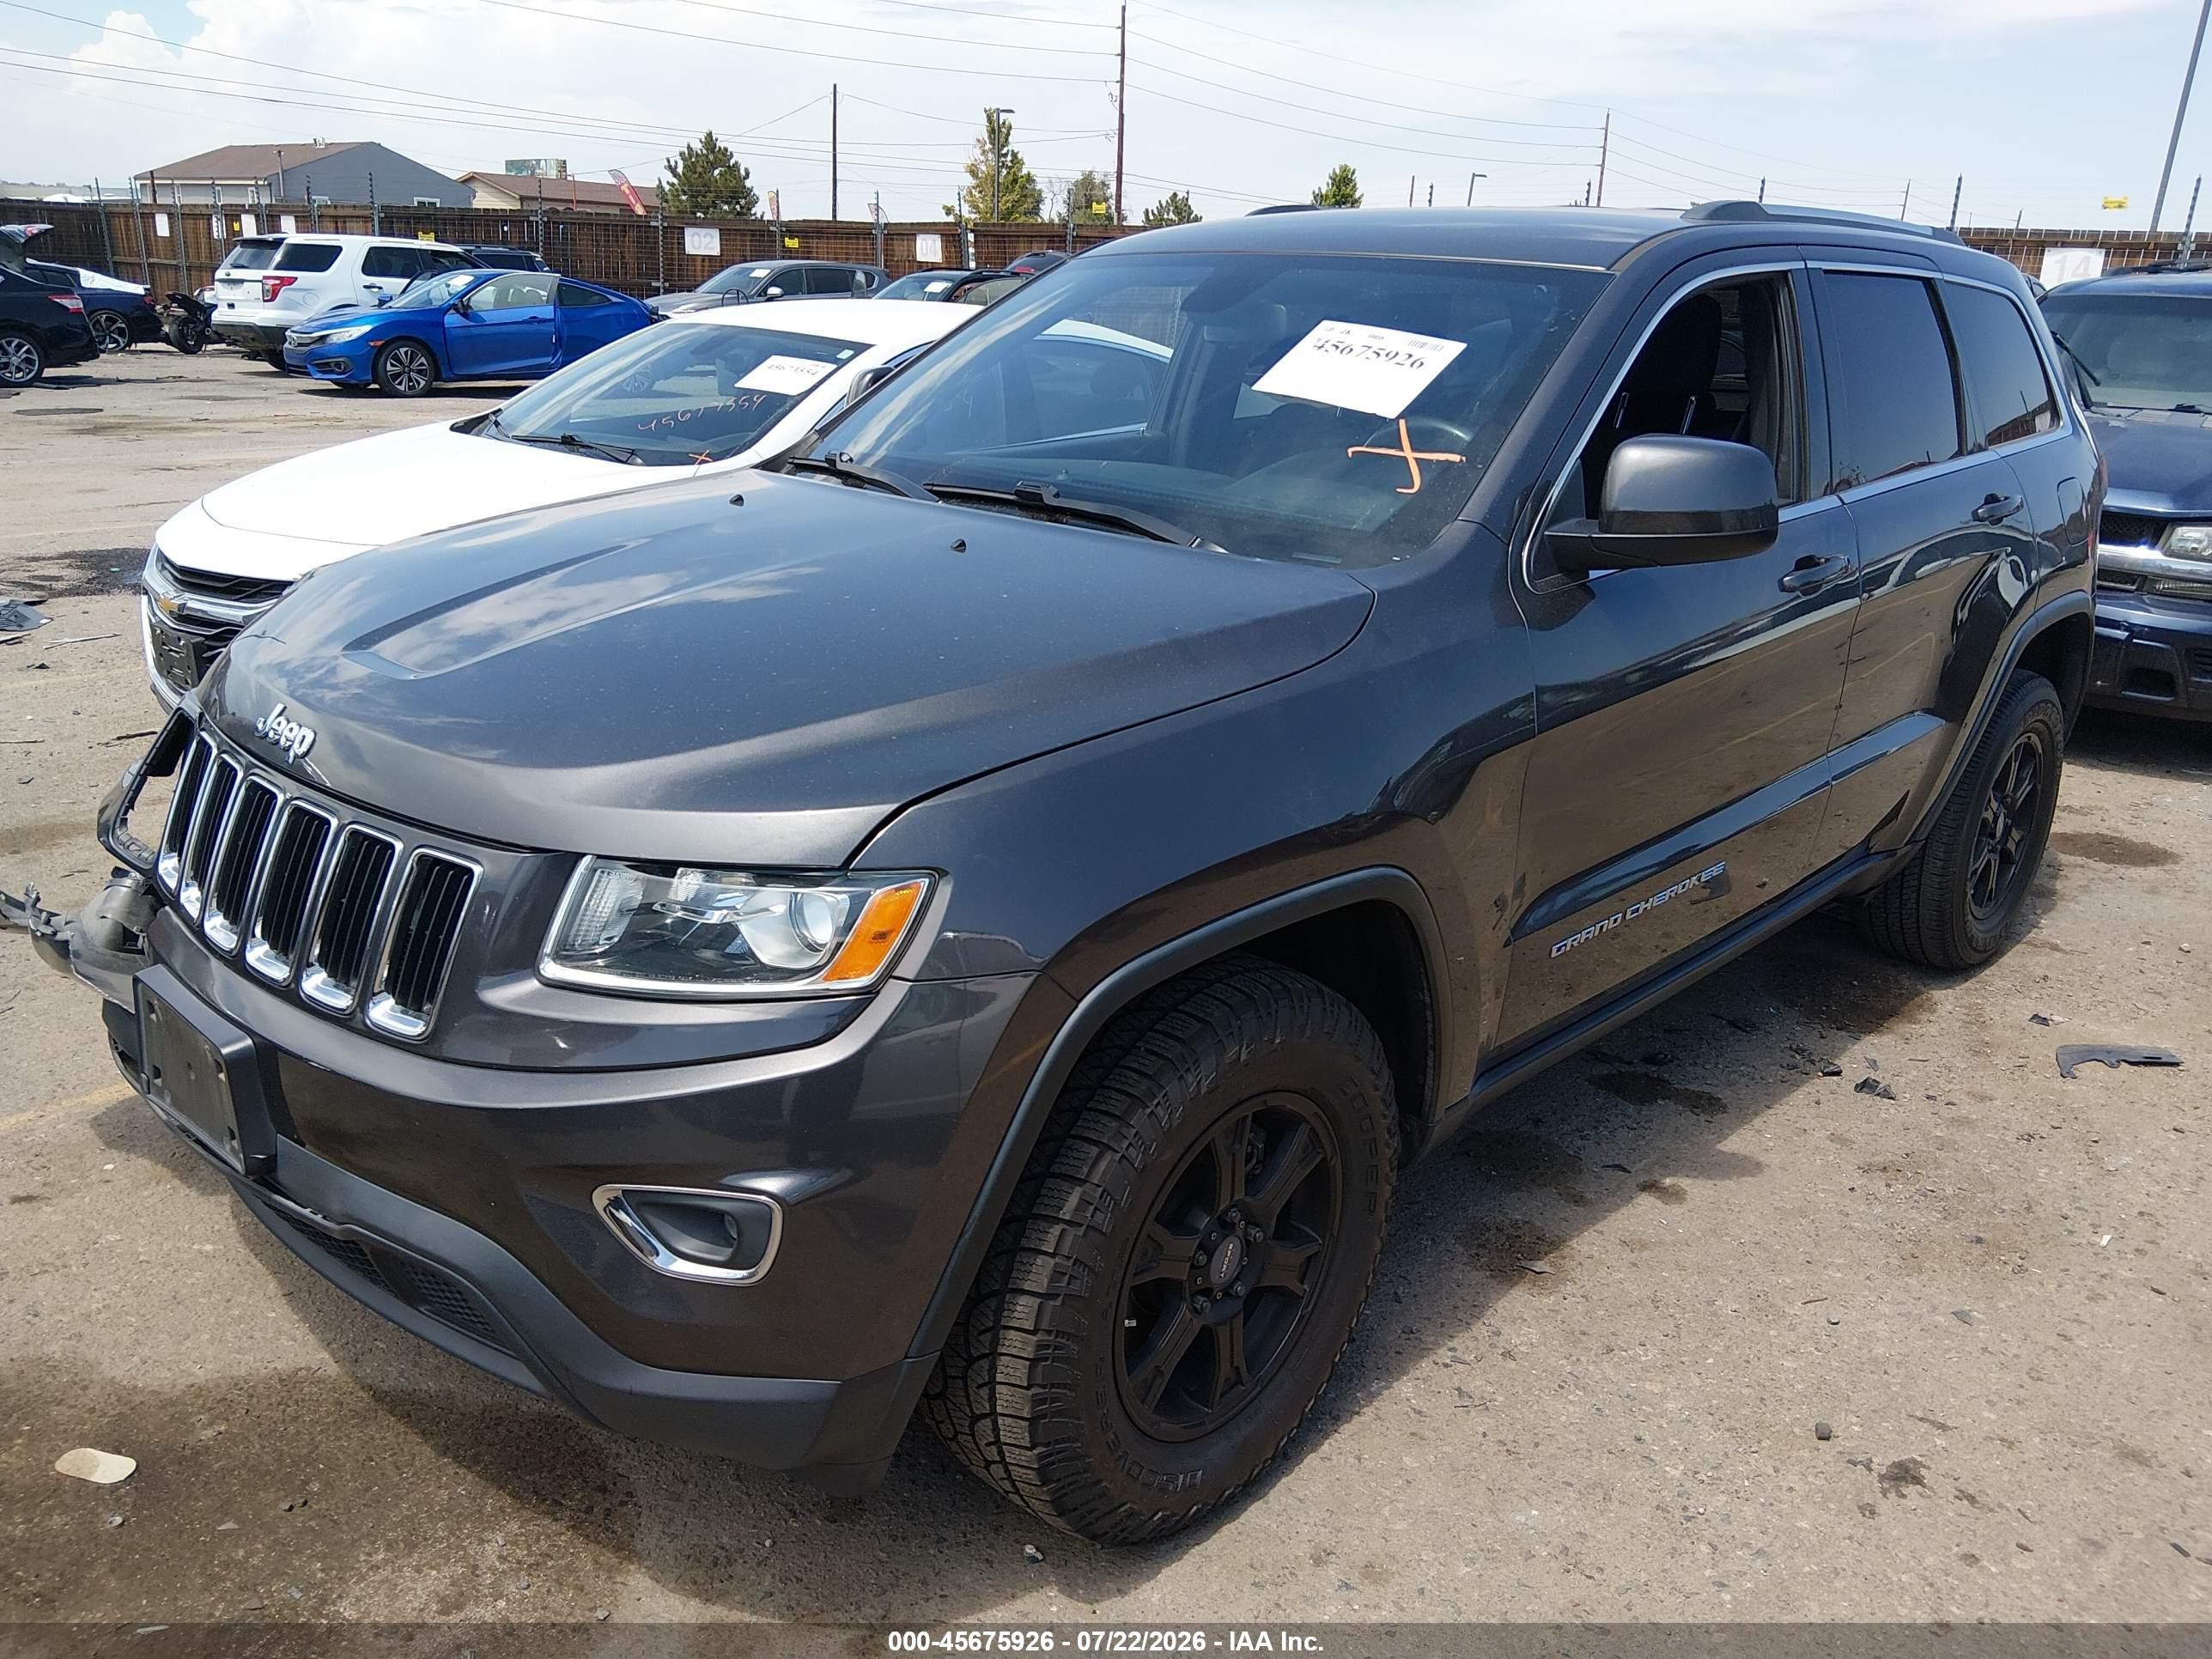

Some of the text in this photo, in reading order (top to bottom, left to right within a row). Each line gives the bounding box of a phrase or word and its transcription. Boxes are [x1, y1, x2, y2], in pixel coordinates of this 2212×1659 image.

[690, 232, 714, 251] 02
[920, 239, 939, 258] 04
[2054, 254, 2094, 284] 14
[1312, 337, 1427, 369] 45675926
[254, 702, 316, 764] Jeep
[1550, 860, 1726, 958] GRAND CHEROKEE
[1340, 1076, 1380, 1218] COOPER
[1219, 1242, 1234, 1279] SPORT
